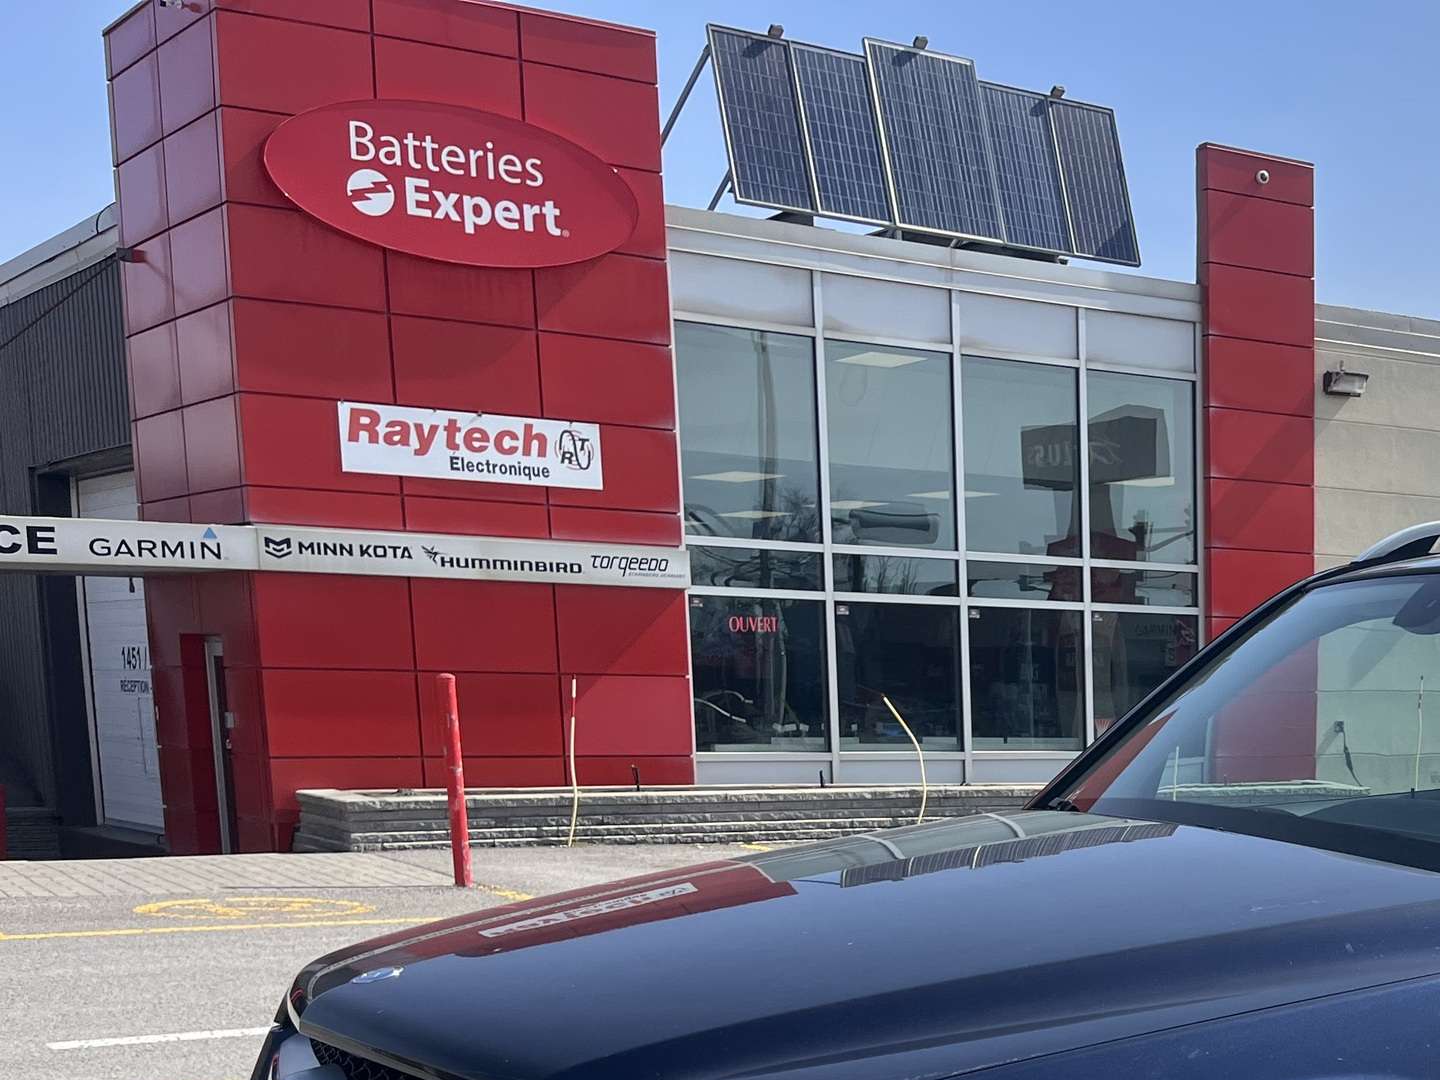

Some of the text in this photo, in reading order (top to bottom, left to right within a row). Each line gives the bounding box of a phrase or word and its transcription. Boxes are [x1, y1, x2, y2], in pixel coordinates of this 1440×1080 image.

[348, 120, 544, 187] Batteries
[404, 176, 561, 237] Expert
[347, 407, 548, 458] Raytech
[450, 451, 550, 481] Électronique
[89, 538, 222, 560] GARMIN
[299, 541, 413, 560] MINN KOTA
[440, 556, 582, 574] HUMMINBIRD
[728, 616, 778, 632] OUVERT
[121, 647, 142, 670] 1451
